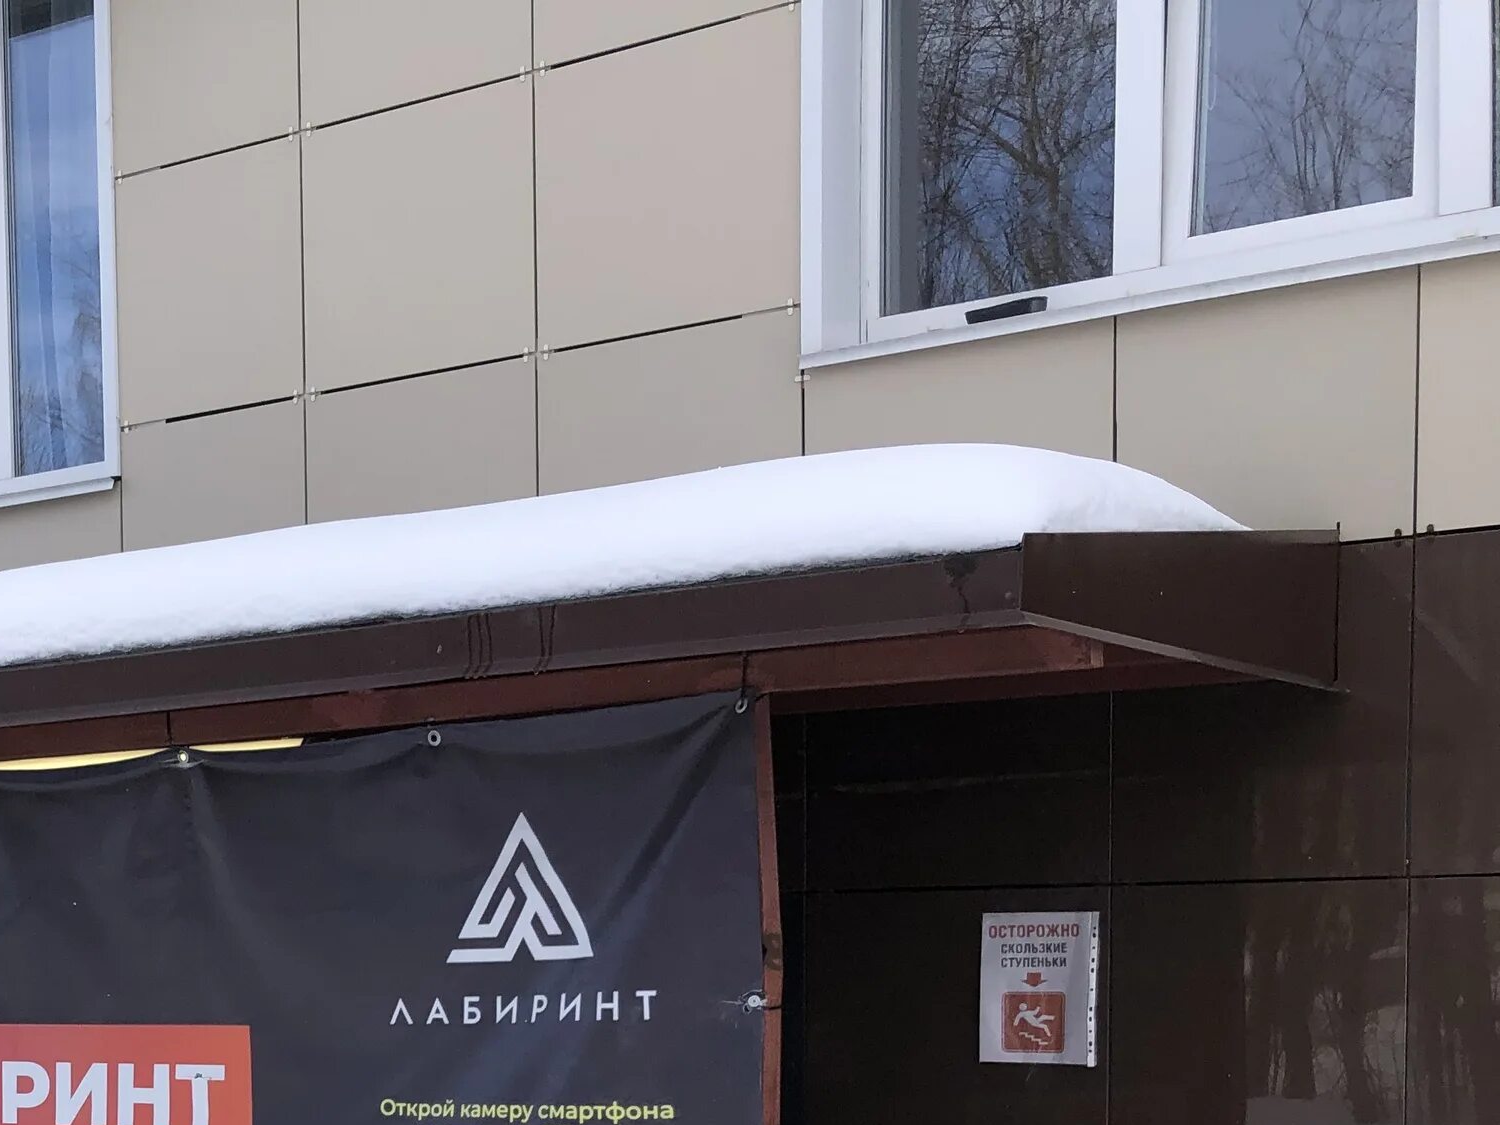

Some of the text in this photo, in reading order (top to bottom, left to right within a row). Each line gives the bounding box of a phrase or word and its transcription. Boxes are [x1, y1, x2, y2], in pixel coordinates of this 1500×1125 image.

[988, 923, 1080, 939] ОСТОРОЖНО
[1001, 942, 1068, 954] СКОЛЬЗКИЕ
[1001, 957, 1067, 968] СТУПЕНЬКИ
[390, 990, 657, 1025] ЛАБИРИНТ
[380, 1099, 675, 1124] Открой камеру смартфона
